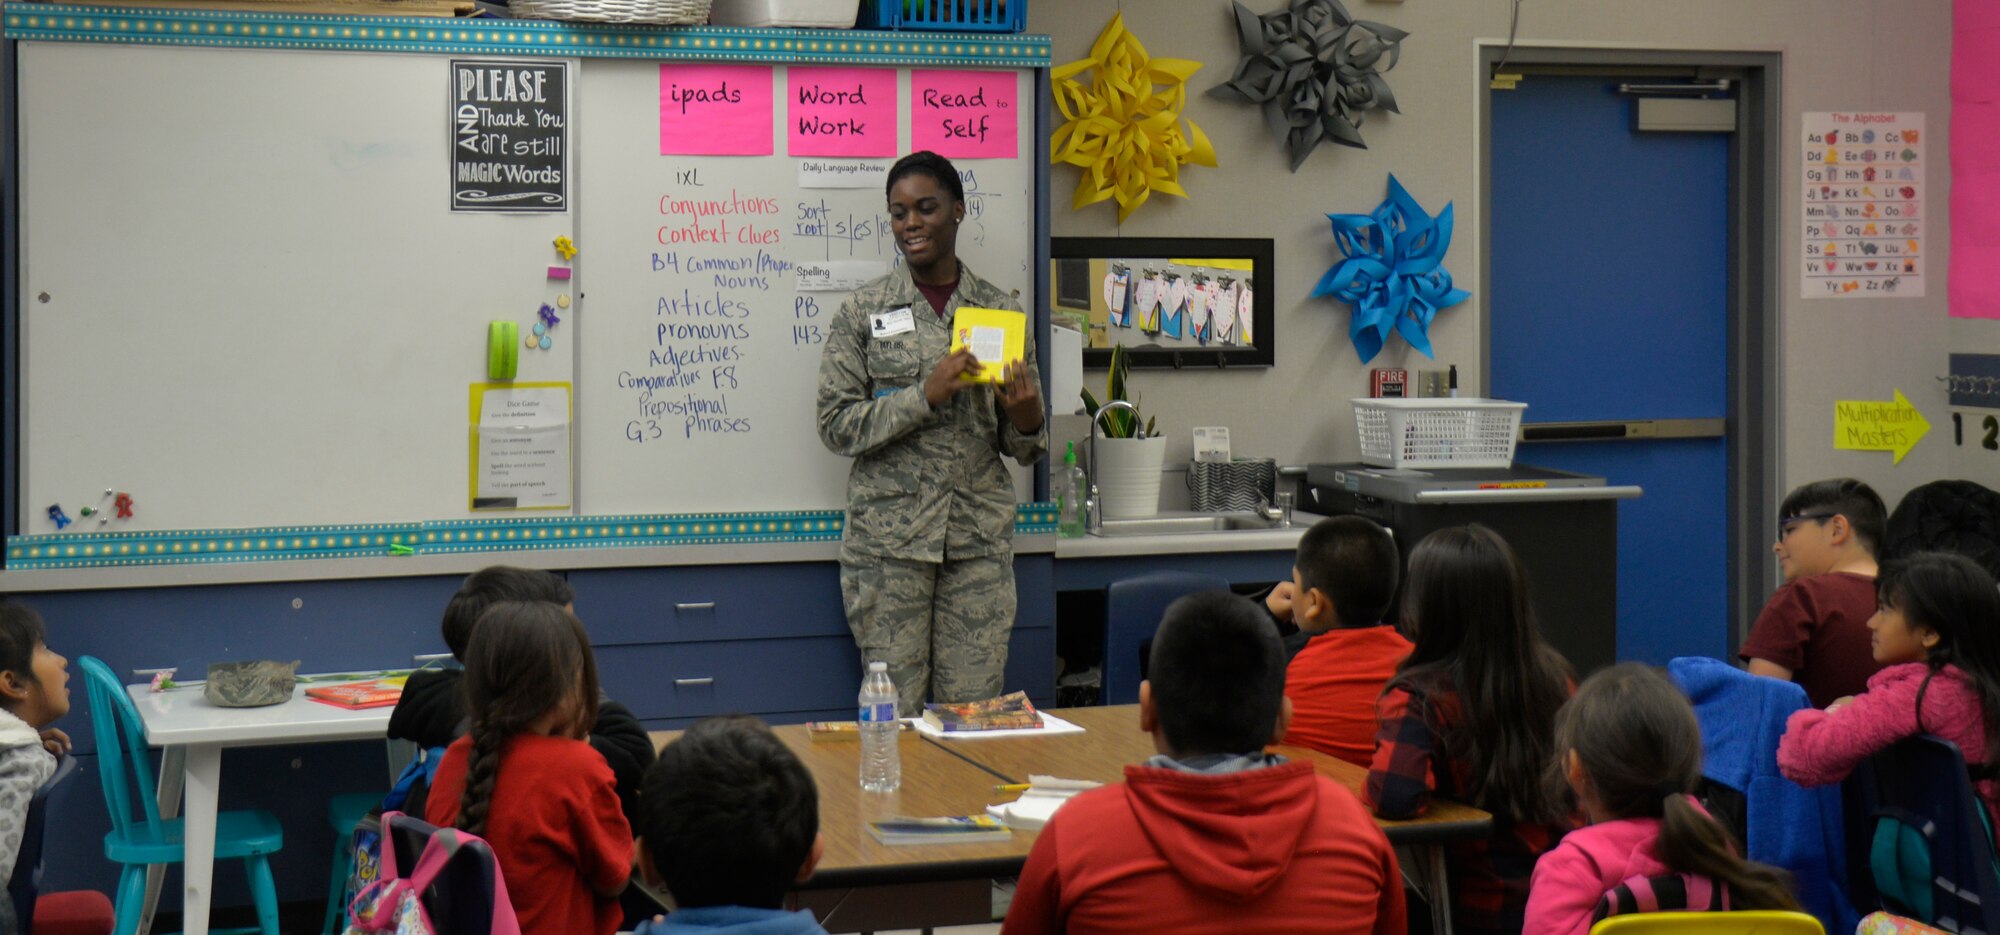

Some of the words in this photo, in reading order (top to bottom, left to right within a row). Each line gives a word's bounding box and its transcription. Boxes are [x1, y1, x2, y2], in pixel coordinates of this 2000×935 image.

[459, 68, 547, 103] PLEASE
[799, 83, 867, 106] Word
[671, 81, 741, 115] ipads
[923, 86, 987, 109] Read
[996, 99, 1008, 108] to
[478, 107, 529, 128] Thank
[534, 108, 564, 128] You
[799, 115, 865, 136] Work
[1832, 113, 1849, 123] The
[1853, 113, 1896, 125] Alphabet
[457, 104, 479, 153] AND
[942, 114, 989, 144] Self
[1807, 134, 1822, 142] Aa
[1845, 134, 1859, 142] Bb
[1885, 134, 1899, 142] Cc
[481, 133, 508, 155] are
[513, 136, 560, 156] still
[1807, 152, 1821, 161] Dd
[1845, 152, 1858, 161] Ee
[1885, 152, 1896, 160] Ff
[457, 161, 503, 183] MAGIC
[502, 164, 561, 184] Words
[803, 162, 821, 173] Daily
[823, 164, 858, 174] Language
[859, 164, 885, 172] Review
[1807, 171, 1821, 181] Gg
[1845, 171, 1859, 179] Hh
[1807, 190, 1815, 200] Jj
[1845, 189, 1858, 197] Kk
[1885, 189, 1894, 197] Ll
[660, 188, 779, 227] Conjunctions
[797, 198, 831, 220] Sort
[1807, 208, 1824, 216] Mm
[1845, 208, 1859, 216] Nn
[1885, 207, 1899, 216] Oo
[658, 219, 731, 245] Context
[1807, 227, 1820, 236] Pp
[1845, 226, 1860, 236] Qq
[1885, 226, 1896, 234] Rr
[1807, 245, 1819, 254] Ss
[1846, 244, 1857, 253] Tt
[1885, 244, 1898, 253] Uu
[651, 251, 679, 272] B4
[1807, 264, 1819, 272] Vv
[1845, 264, 1862, 272] Ww
[1885, 263, 1897, 271] Xx
[714, 274, 769, 291] Nouns
[796, 266, 830, 279] Spelling
[1826, 281, 1838, 291] Yy
[1866, 281, 1878, 289] Zz
[657, 288, 750, 319] Articles
[795, 296, 819, 319] PB
[1380, 371, 1404, 381] FIRE
[638, 392, 727, 419] Prepositional
[1837, 402, 1920, 428] Multiplication
[1847, 426, 1908, 447] Masters
[1952, 412, 1962, 446] 1
[1982, 415, 1999, 451] 2
